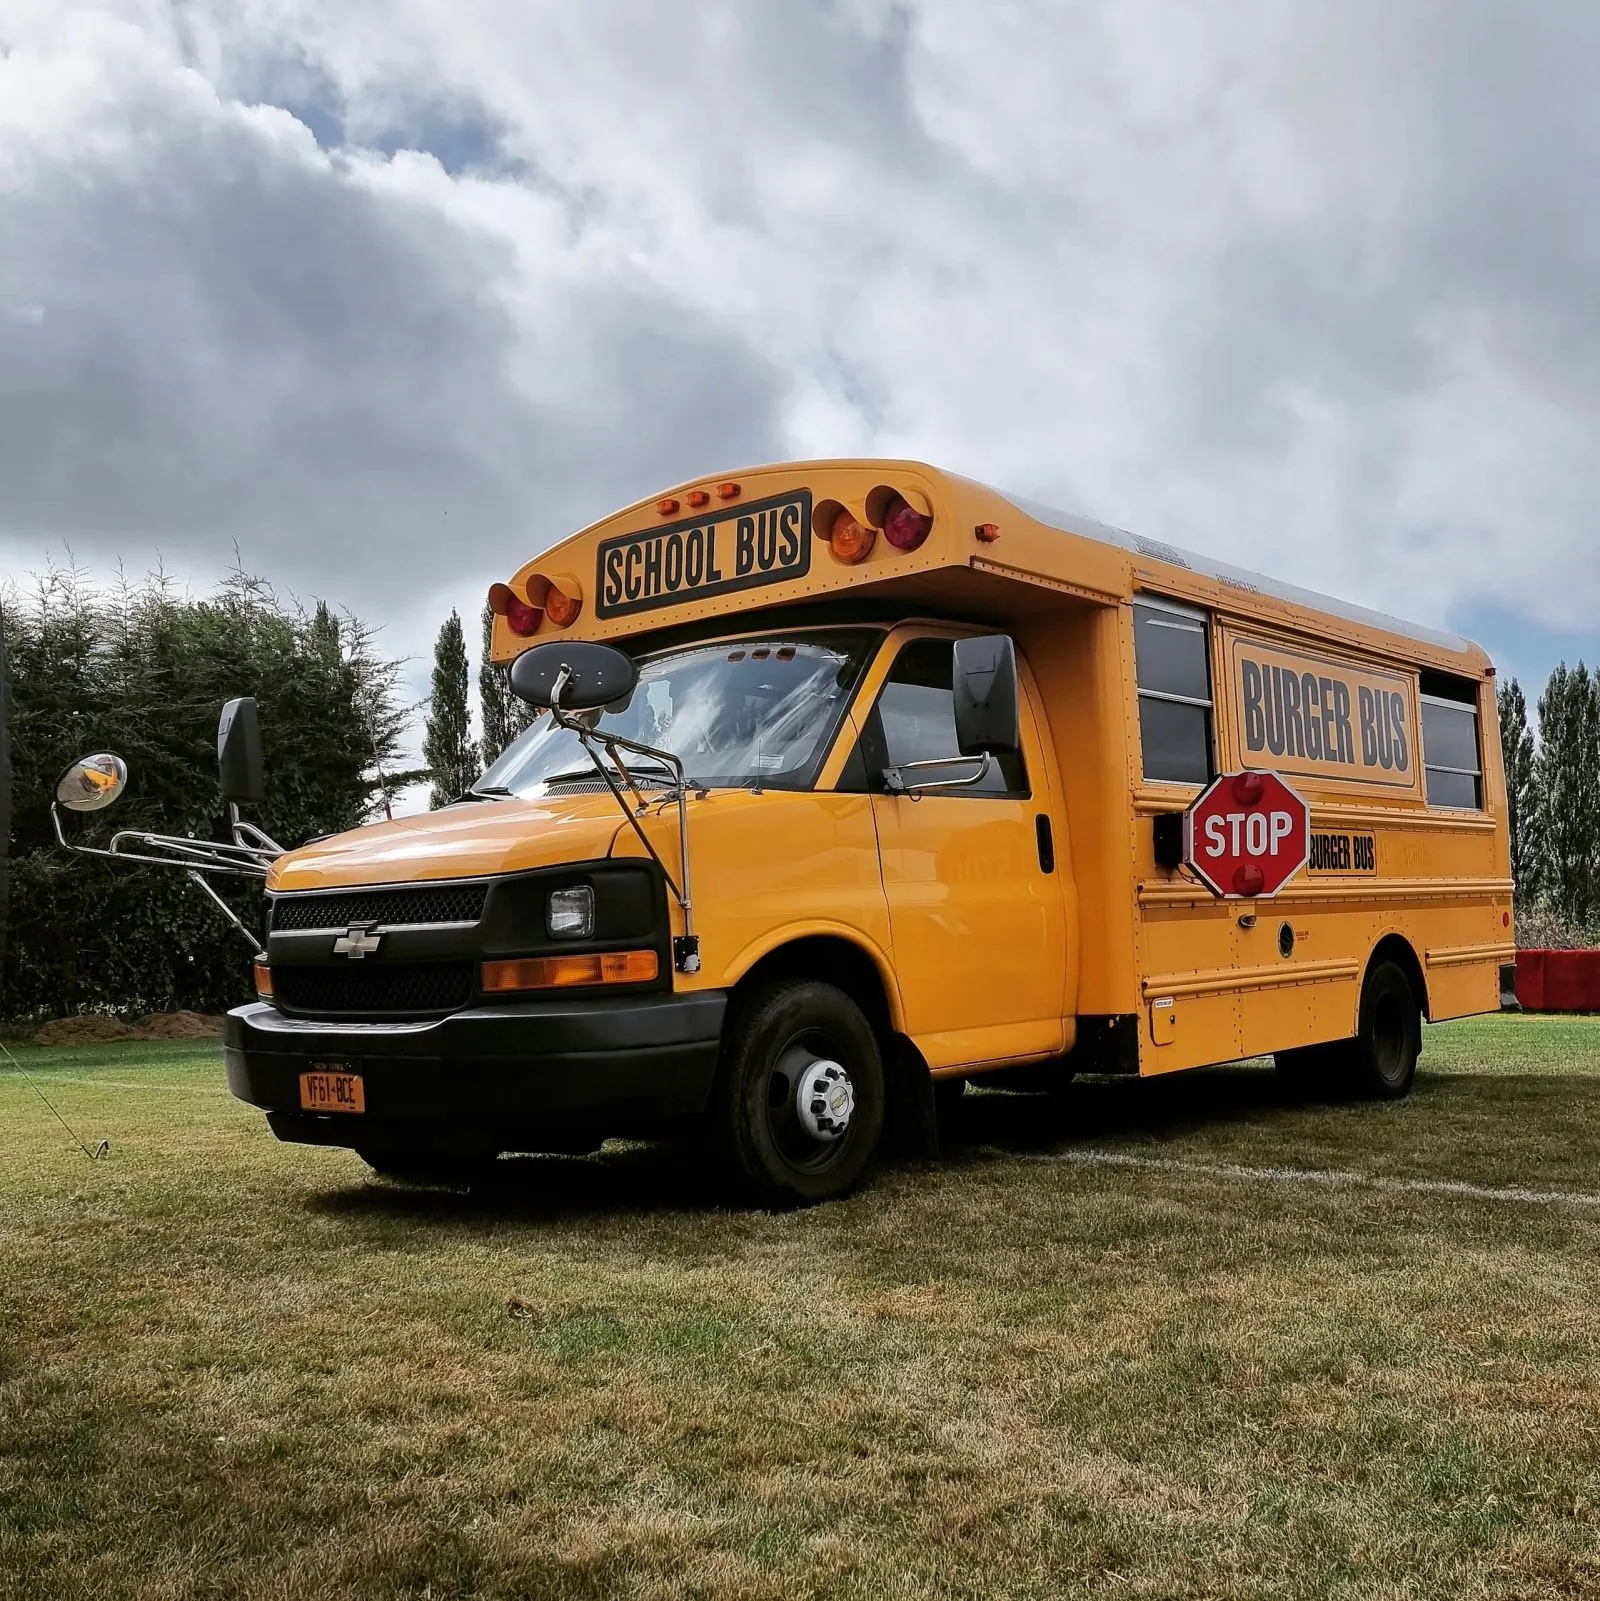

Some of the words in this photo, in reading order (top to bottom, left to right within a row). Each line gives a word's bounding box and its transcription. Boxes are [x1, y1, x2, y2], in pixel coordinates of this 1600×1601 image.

[605, 525, 722, 605] SCHOOL
[735, 504, 800, 577] BUS
[1241, 658, 1356, 765] BURGER
[1358, 685, 1409, 772] BUS
[1204, 811, 1293, 858] STOP
[1308, 833, 1351, 871] BURGER
[1352, 835, 1375, 871] BUS
